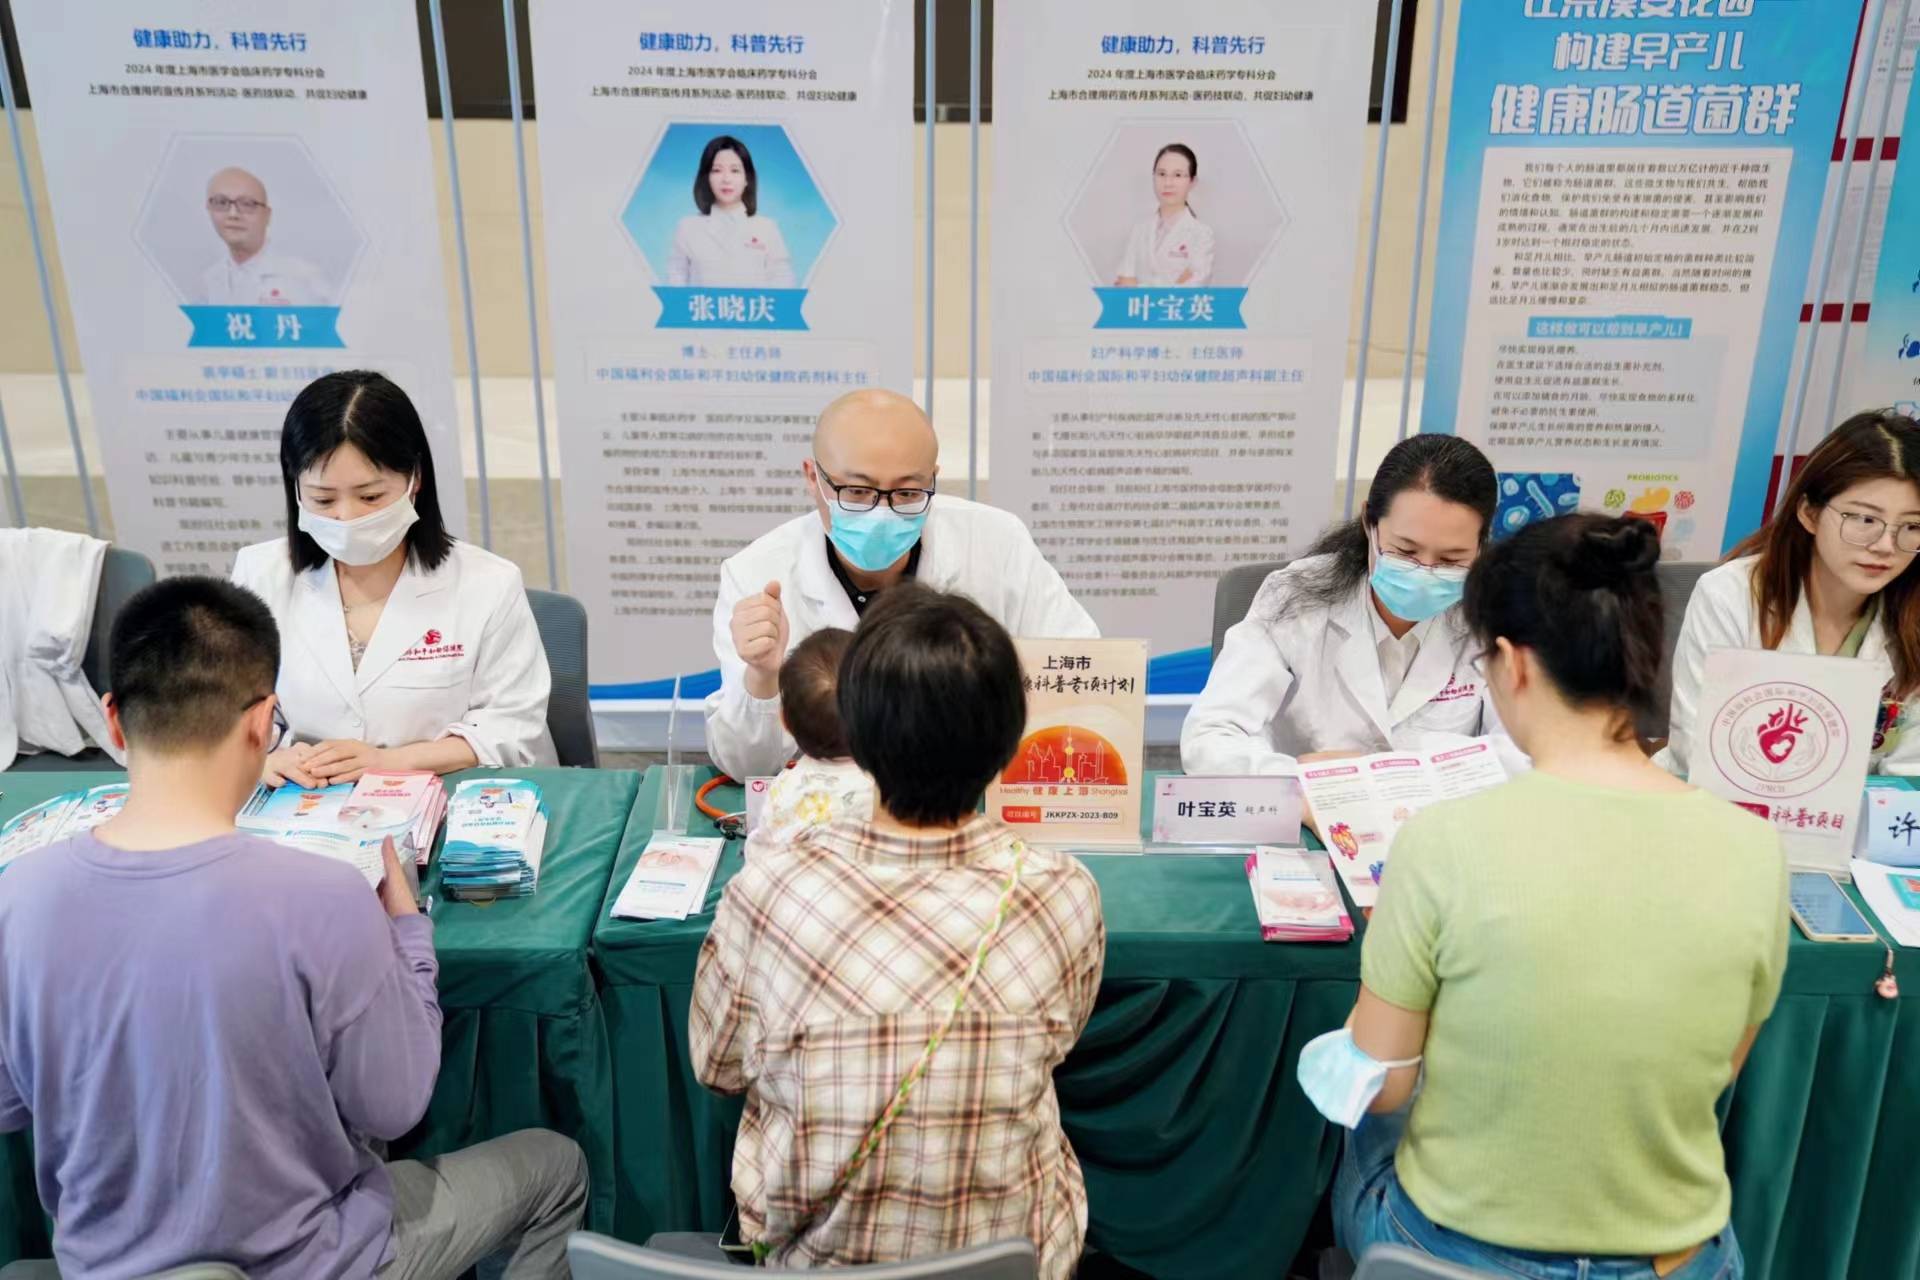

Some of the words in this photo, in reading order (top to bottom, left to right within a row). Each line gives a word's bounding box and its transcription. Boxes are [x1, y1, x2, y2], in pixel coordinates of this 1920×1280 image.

[133, 28, 308, 53] 健康助力，科普先行
[639, 32, 803, 55] 健康助力，科普先行
[1101, 35, 1266, 56] 健康助力，科普先行
[1553, 31, 1745, 73] 构建早产儿
[125, 64, 152, 75] 2024
[627, 66, 653, 77] 2024
[1087, 69, 1113, 80] 2024
[1489, 83, 1801, 137] 健康肠道菌群
[688, 294, 777, 323] 张晓庆
[1127, 295, 1216, 322] 叶宝英
[1043, 655, 1092, 671] 上海市
[1177, 801, 1237, 818] 叶宝英
[1887, 811, 1920, 847] 许
